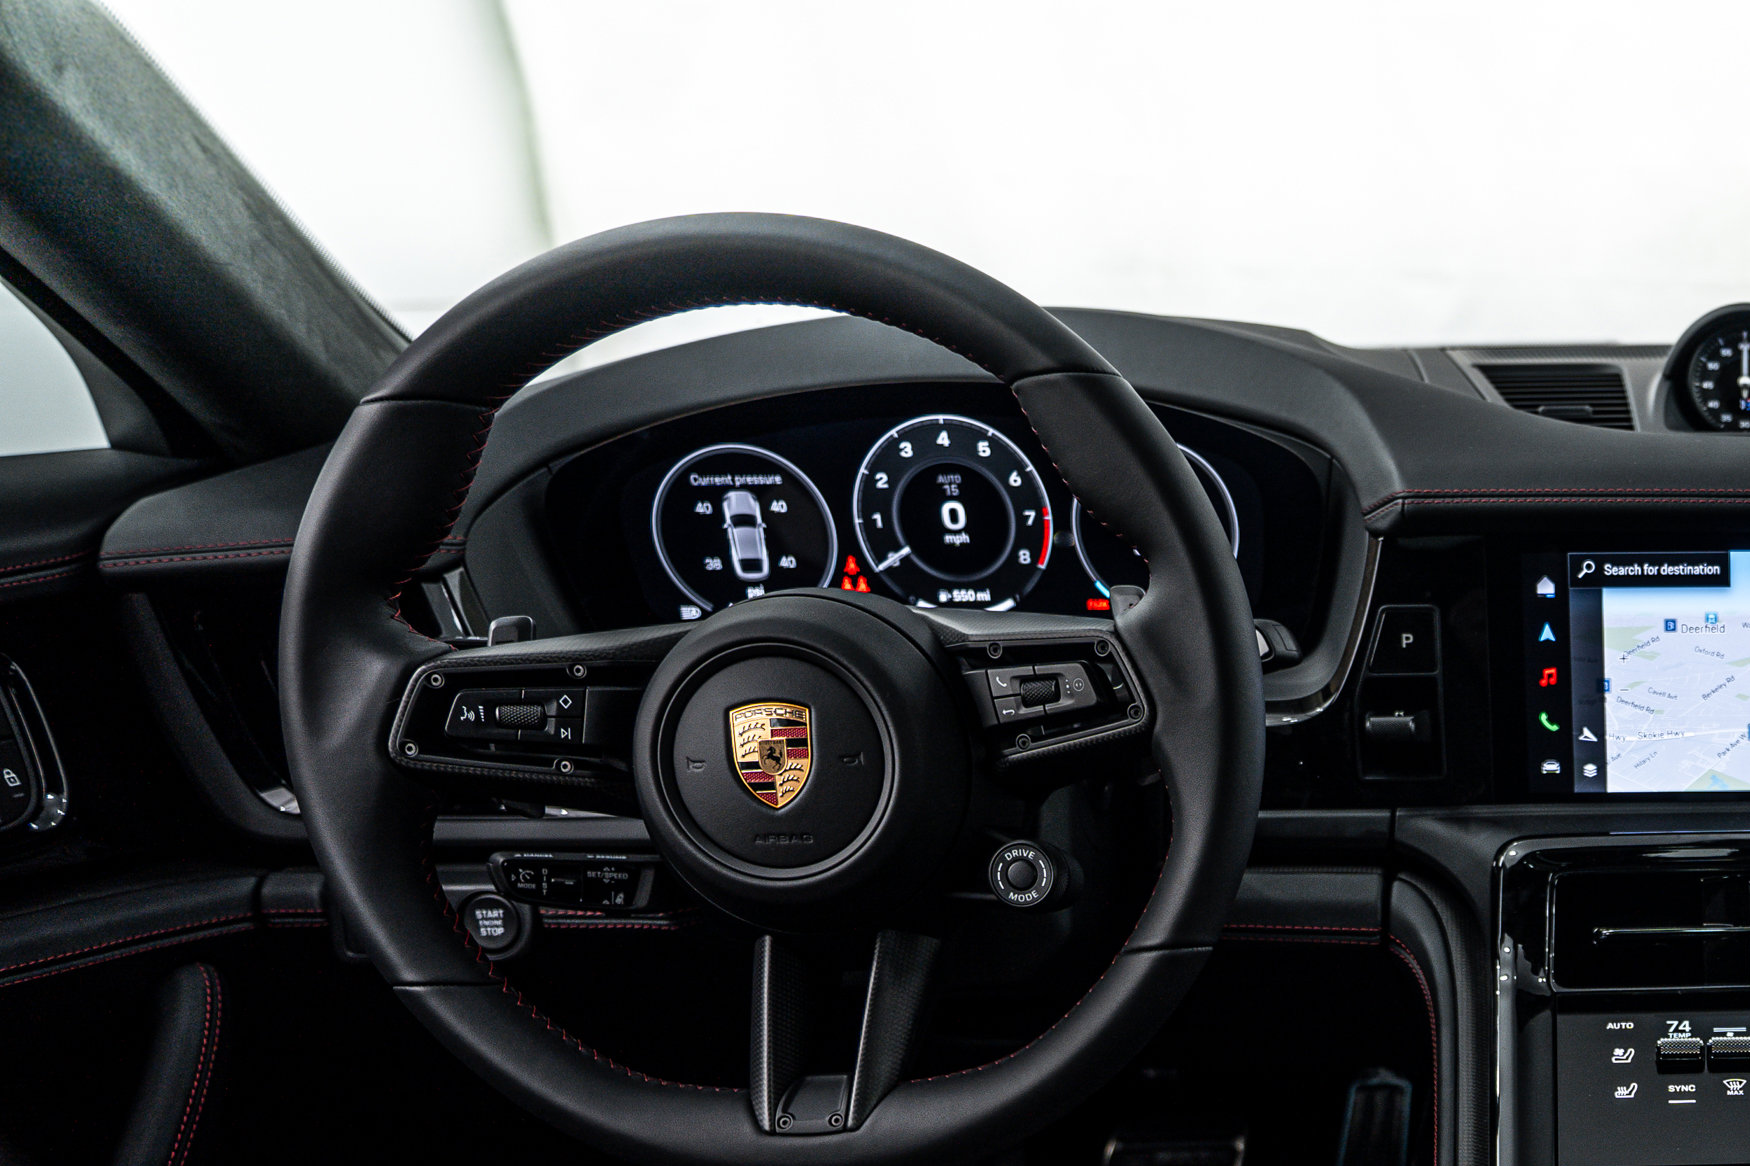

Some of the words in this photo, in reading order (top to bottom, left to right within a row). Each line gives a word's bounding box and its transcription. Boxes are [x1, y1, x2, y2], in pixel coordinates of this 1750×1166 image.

[936, 430, 950, 447] 4
[899, 441, 914, 458] 3
[976, 441, 991, 457] 5
[690, 473, 733, 486] Current
[735, 473, 783, 487] pressure
[875, 472, 889, 489] 2
[936, 474, 962, 484] AUTO
[1008, 471, 1022, 487] 6
[694, 501, 713, 514] 40
[770, 500, 788, 513] 40
[871, 512, 884, 528] 1
[941, 501, 967, 531] 0
[1022, 510, 1036, 526] 7
[944, 533, 970, 546] mph
[779, 556, 797, 569] 40
[1018, 550, 1031, 564] 8
[1603, 563, 1641, 576] Search
[1643, 563, 1658, 575] for
[1660, 563, 1720, 576] destination
[976, 588, 991, 601] mi
[1681, 624, 1725, 634] Deerfield
[1402, 634, 1413, 648] P
[1725, 675, 1735, 684] Rd
[1616, 696, 1645, 711] Deerfield
[1645, 706, 1655, 715] Rd
[735, 707, 806, 721] PORSCHE
[1609, 733, 1626, 742] Hwy
[1638, 731, 1665, 740] Skokie
[1667, 730, 1685, 738] Hwy
[754, 832, 814, 845] AIRBAG
[1004, 848, 1036, 861] DRIVE
[1008, 889, 1039, 902] MODE
[475, 908, 504, 919] START
[480, 927, 504, 936] STOP
[1606, 1022, 1634, 1030] AUTO
[1666, 1020, 1692, 1033] 74
[1667, 1084, 1696, 1093] SYNC
